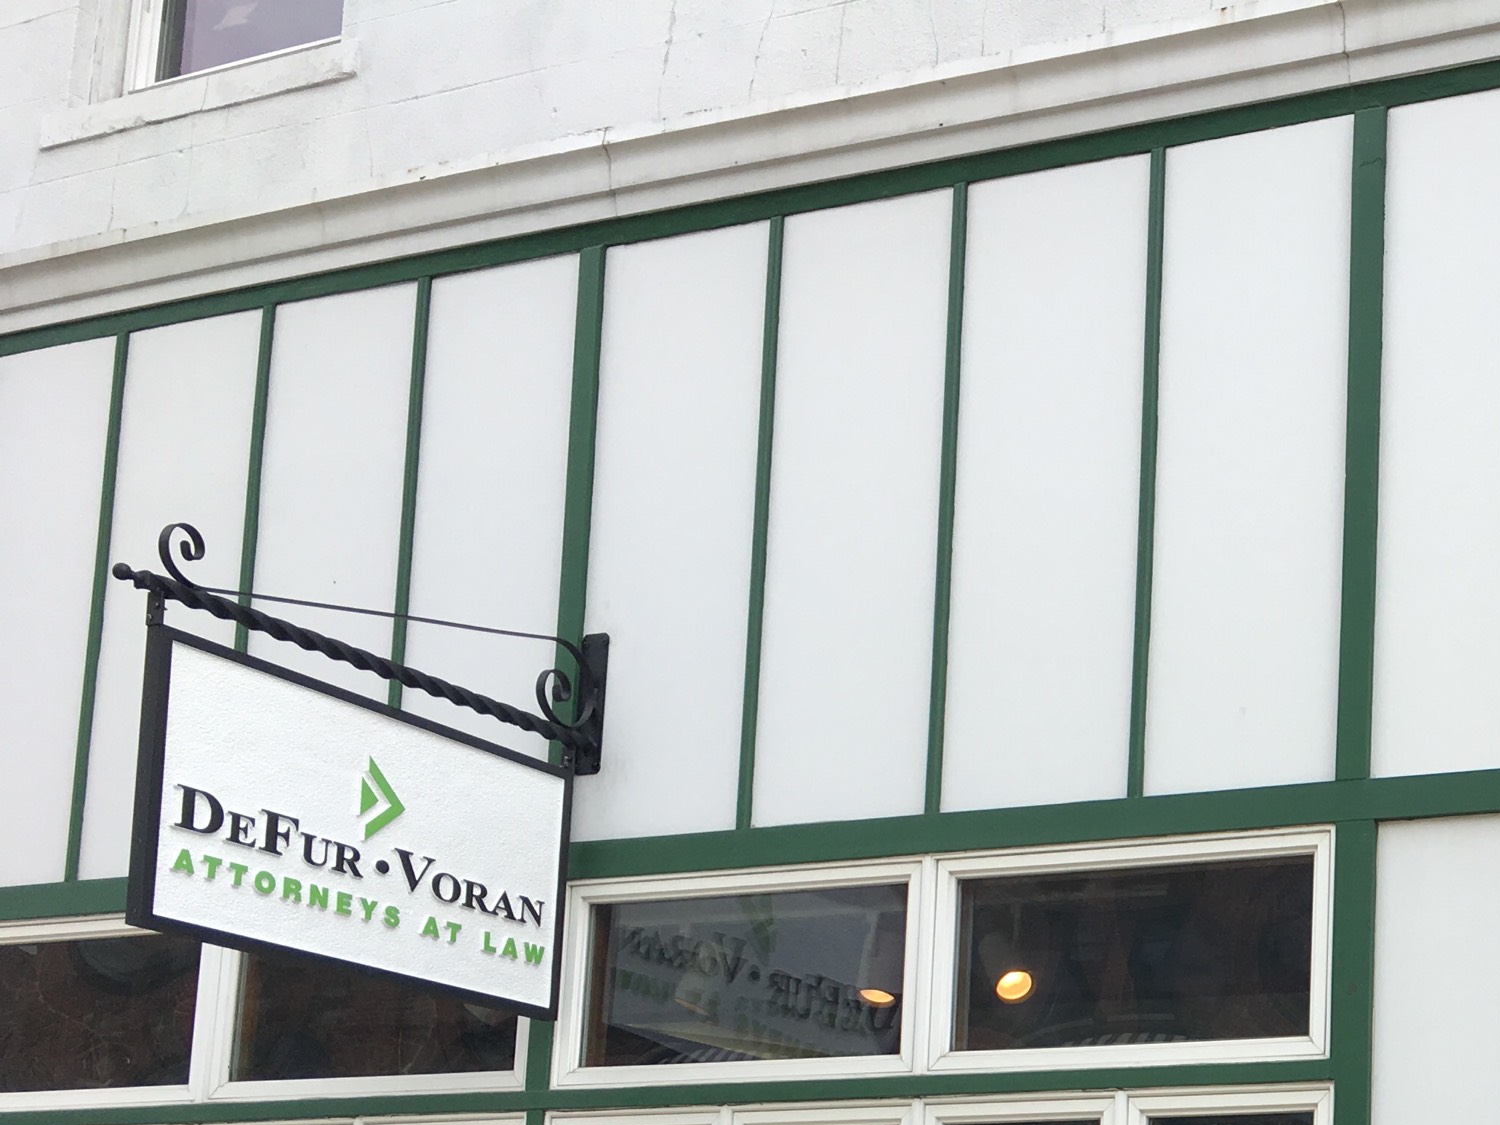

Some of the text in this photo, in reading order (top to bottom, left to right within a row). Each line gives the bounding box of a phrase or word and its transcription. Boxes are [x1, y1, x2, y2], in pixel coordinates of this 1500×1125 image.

[172, 848, 546, 966] ATTORNEYS AT LAW
